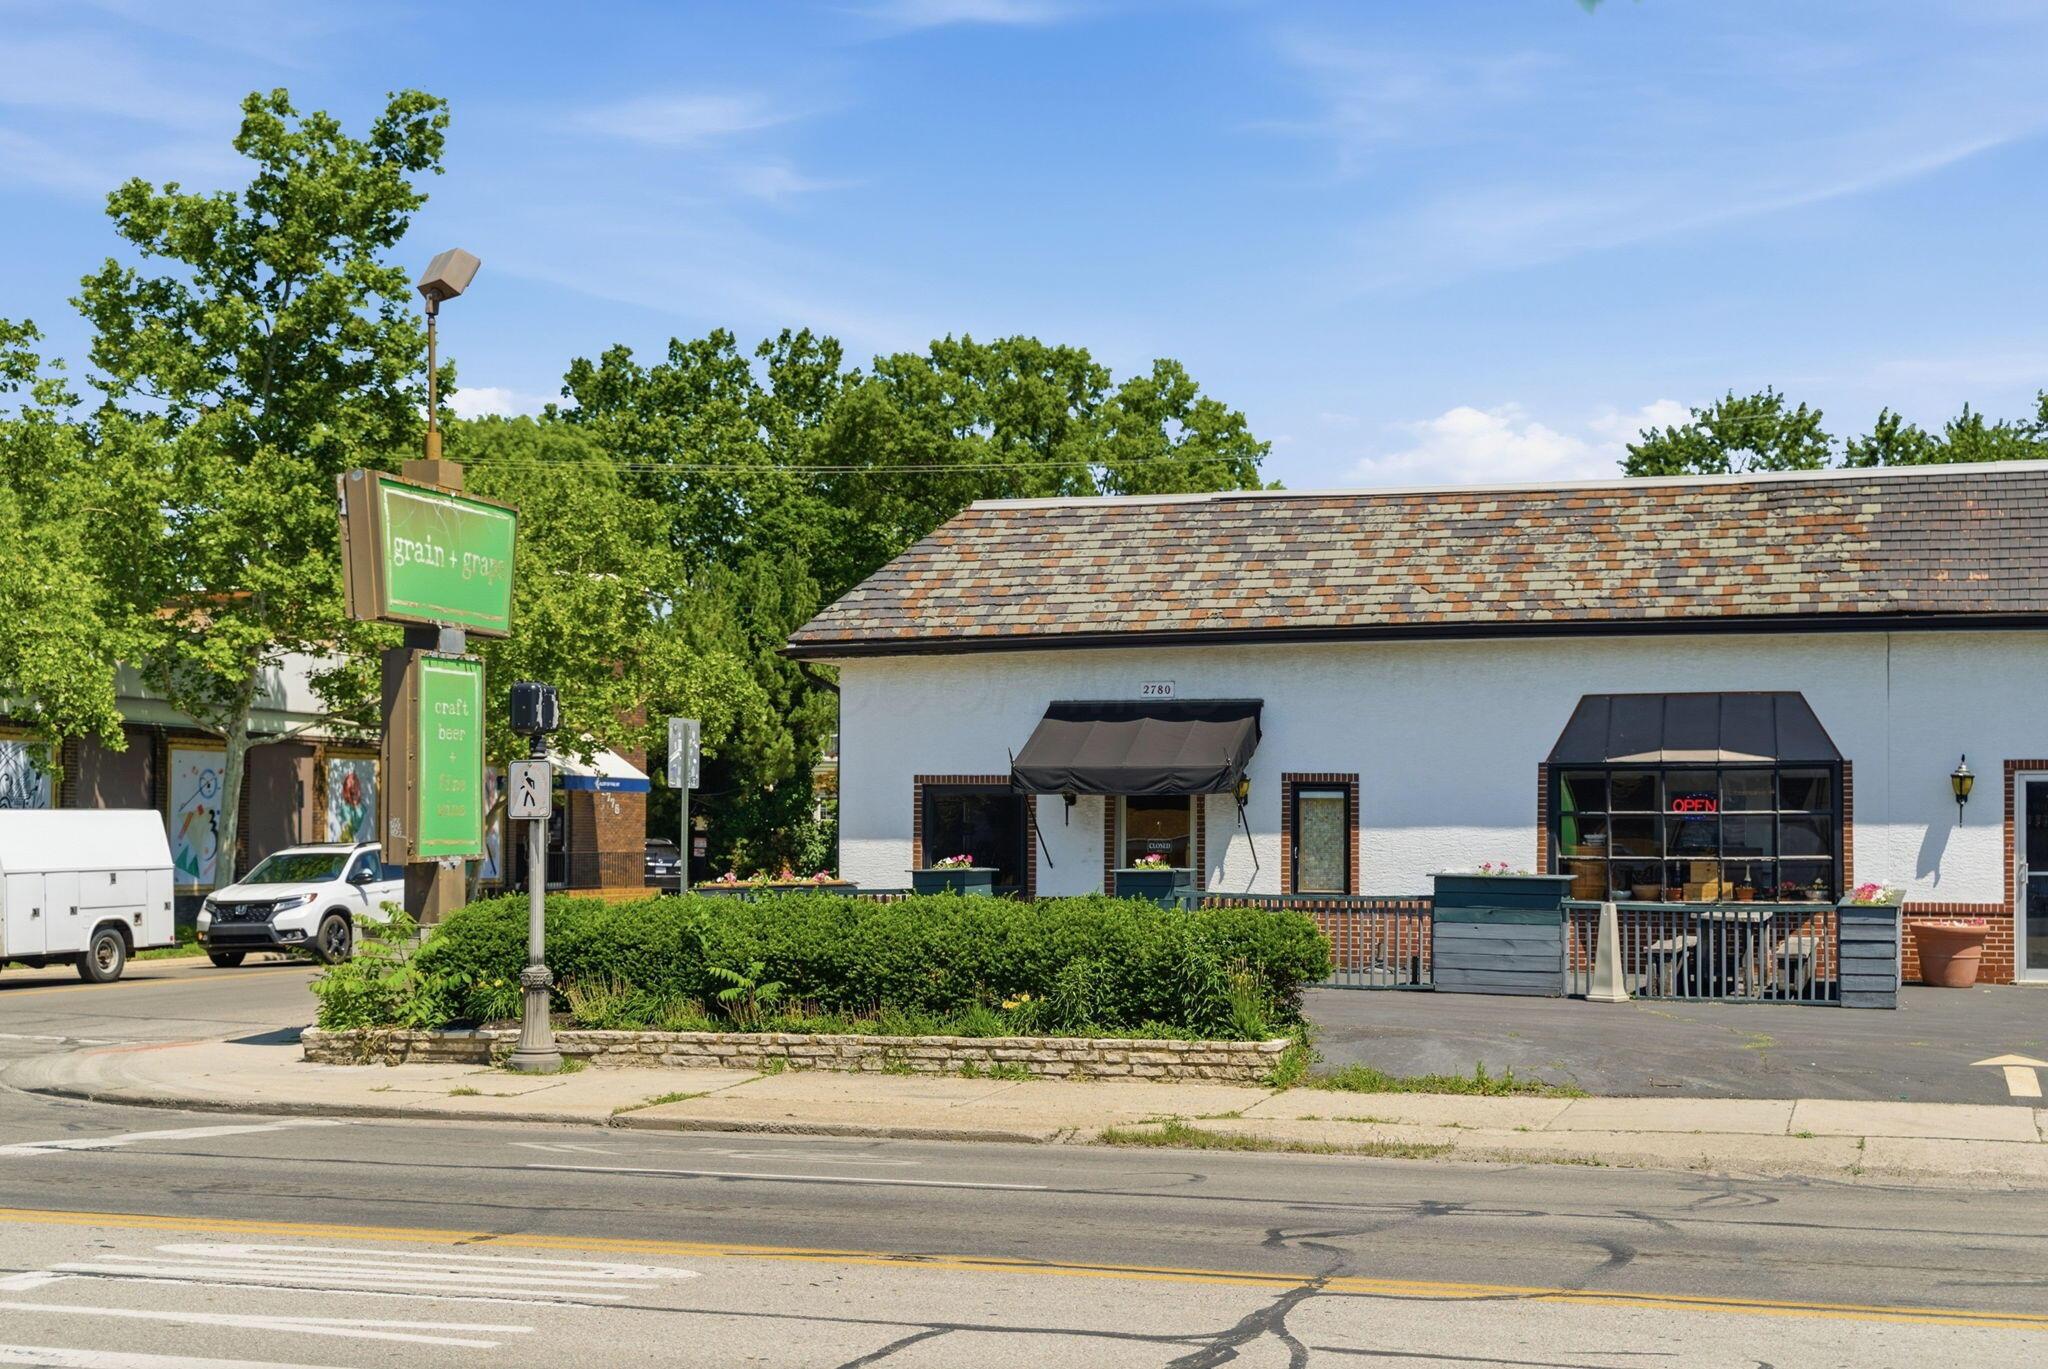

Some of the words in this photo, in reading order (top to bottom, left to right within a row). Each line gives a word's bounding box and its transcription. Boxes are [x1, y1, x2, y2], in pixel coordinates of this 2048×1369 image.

[393, 535, 445, 567] grain
[449, 552, 457, 568] +
[1143, 684, 1171, 695] 2780
[434, 698, 470, 716] craft
[438, 722, 466, 741] beer
[1673, 799, 1717, 813] OPEN
